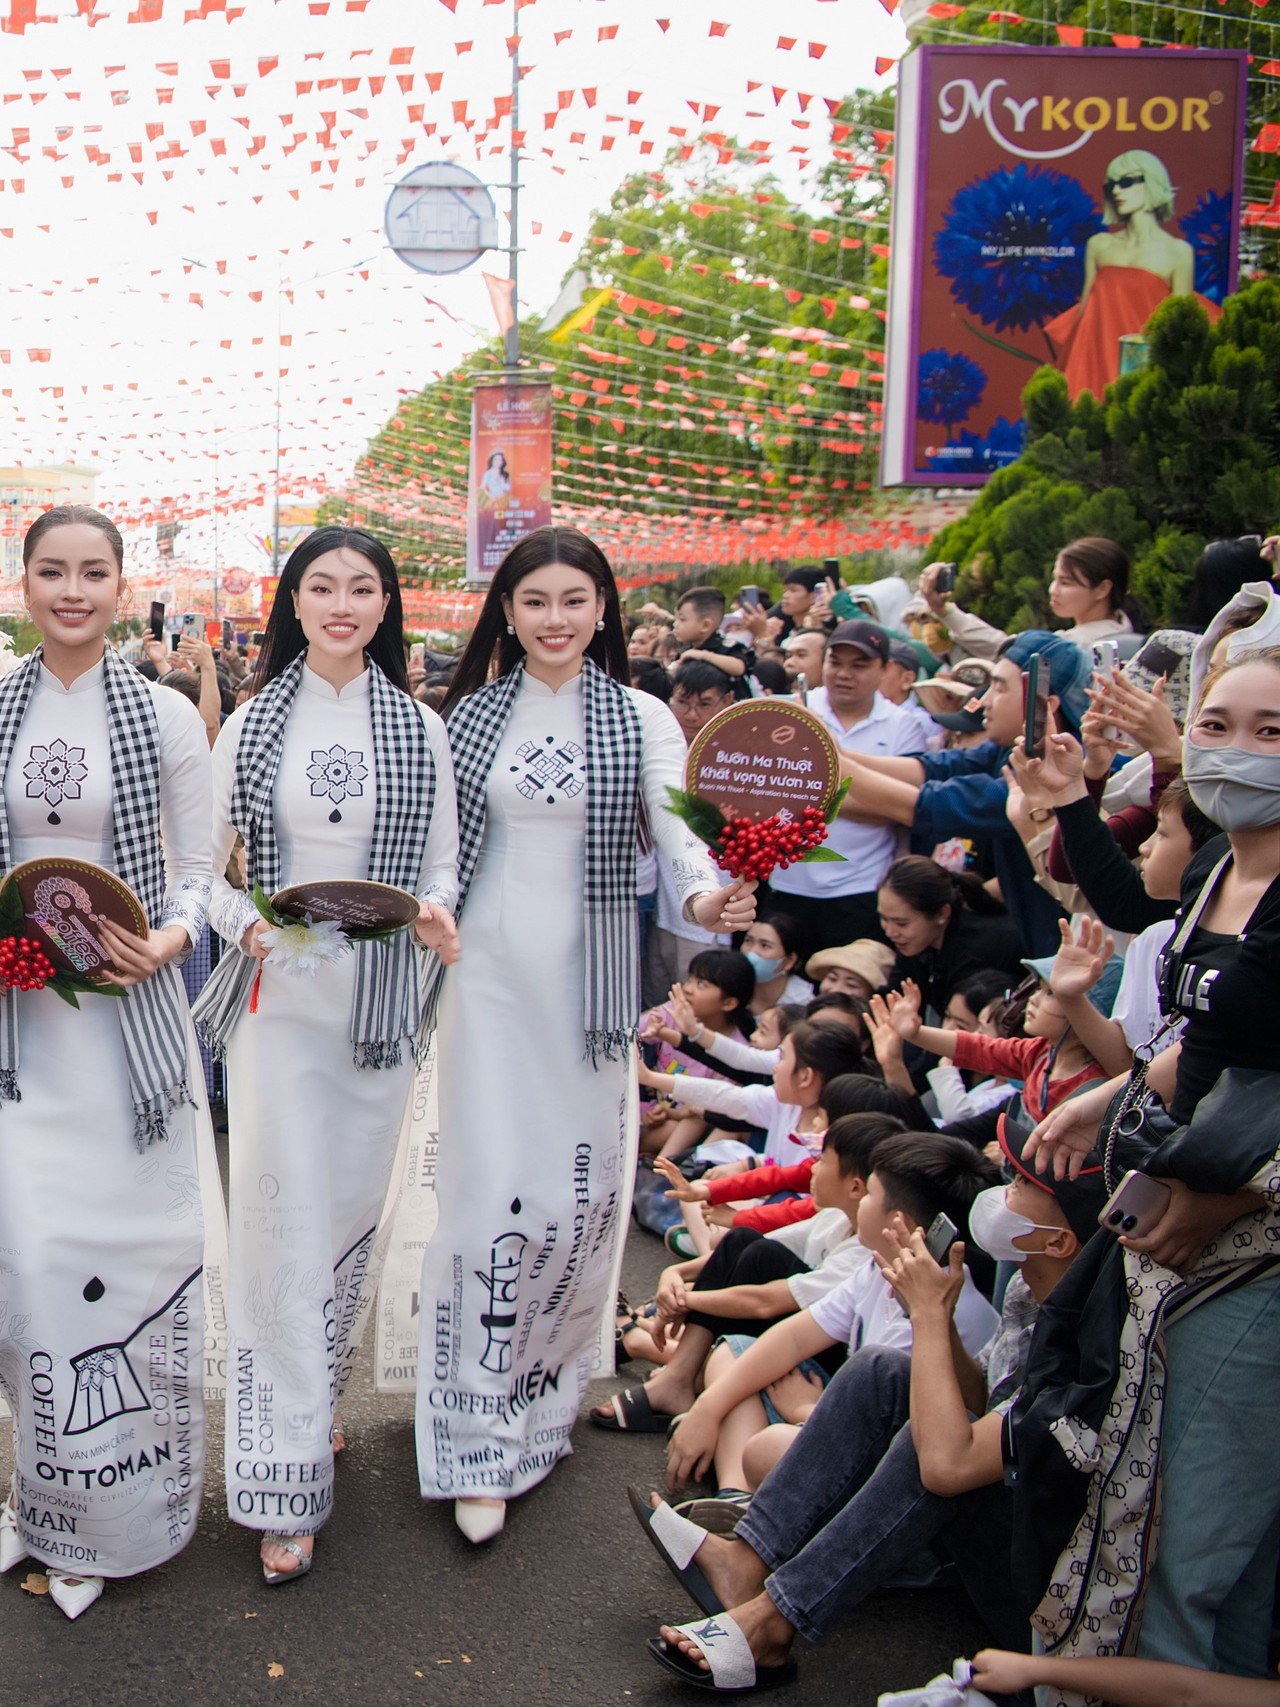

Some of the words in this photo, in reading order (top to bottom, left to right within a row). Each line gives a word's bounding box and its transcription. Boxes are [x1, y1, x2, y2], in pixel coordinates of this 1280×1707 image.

[700, 766, 730, 780] Khát
[733, 772, 766, 786] vọng
[769, 776, 803, 788] vươn
[806, 779, 823, 790] xa
[749, 788, 782, 798] Aspiration
[790, 792, 808, 801] reach
[752, 755, 772, 768] Ma
[776, 757, 813, 774] Thuột
[63, 947, 90, 973] 2025
[573, 1142, 592, 1209] COFFEE
[529, 1221, 559, 1280] COFFEE
[542, 1214, 585, 1316] CIVILIZATION
[335, 1236, 373, 1358] CIVILIZATION
[434, 1299, 451, 1382] COFFEE
[517, 1300, 540, 1360] COFFEE
[150, 1334, 171, 1427] COFFEE
[171, 1295, 191, 1426] CIVILIZATION
[29, 1350, 57, 1458] COFFEE
[237, 1346, 254, 1453] OTTOMAN
[259, 1382, 274, 1455] COFFEE
[428, 1386, 506, 1416] COFFEE
[36, 1440, 172, 1490] OTTOMAN
[69, 1449, 88, 1462] VĂN
[89, 1442, 110, 1459] MINH
[110, 1434, 121, 1449] CÀ
[121, 1428, 136, 1443] PHÊ
[235, 1459, 320, 1484] COFFEE
[28, 1489, 88, 1514] OTTOMAN
[56, 1489, 94, 1504] COFFEE
[100, 1475, 155, 1503] CIVILIZATION
[177, 1430, 192, 1526] OTTOMAN
[162, 1477, 183, 1547] COFFEE
